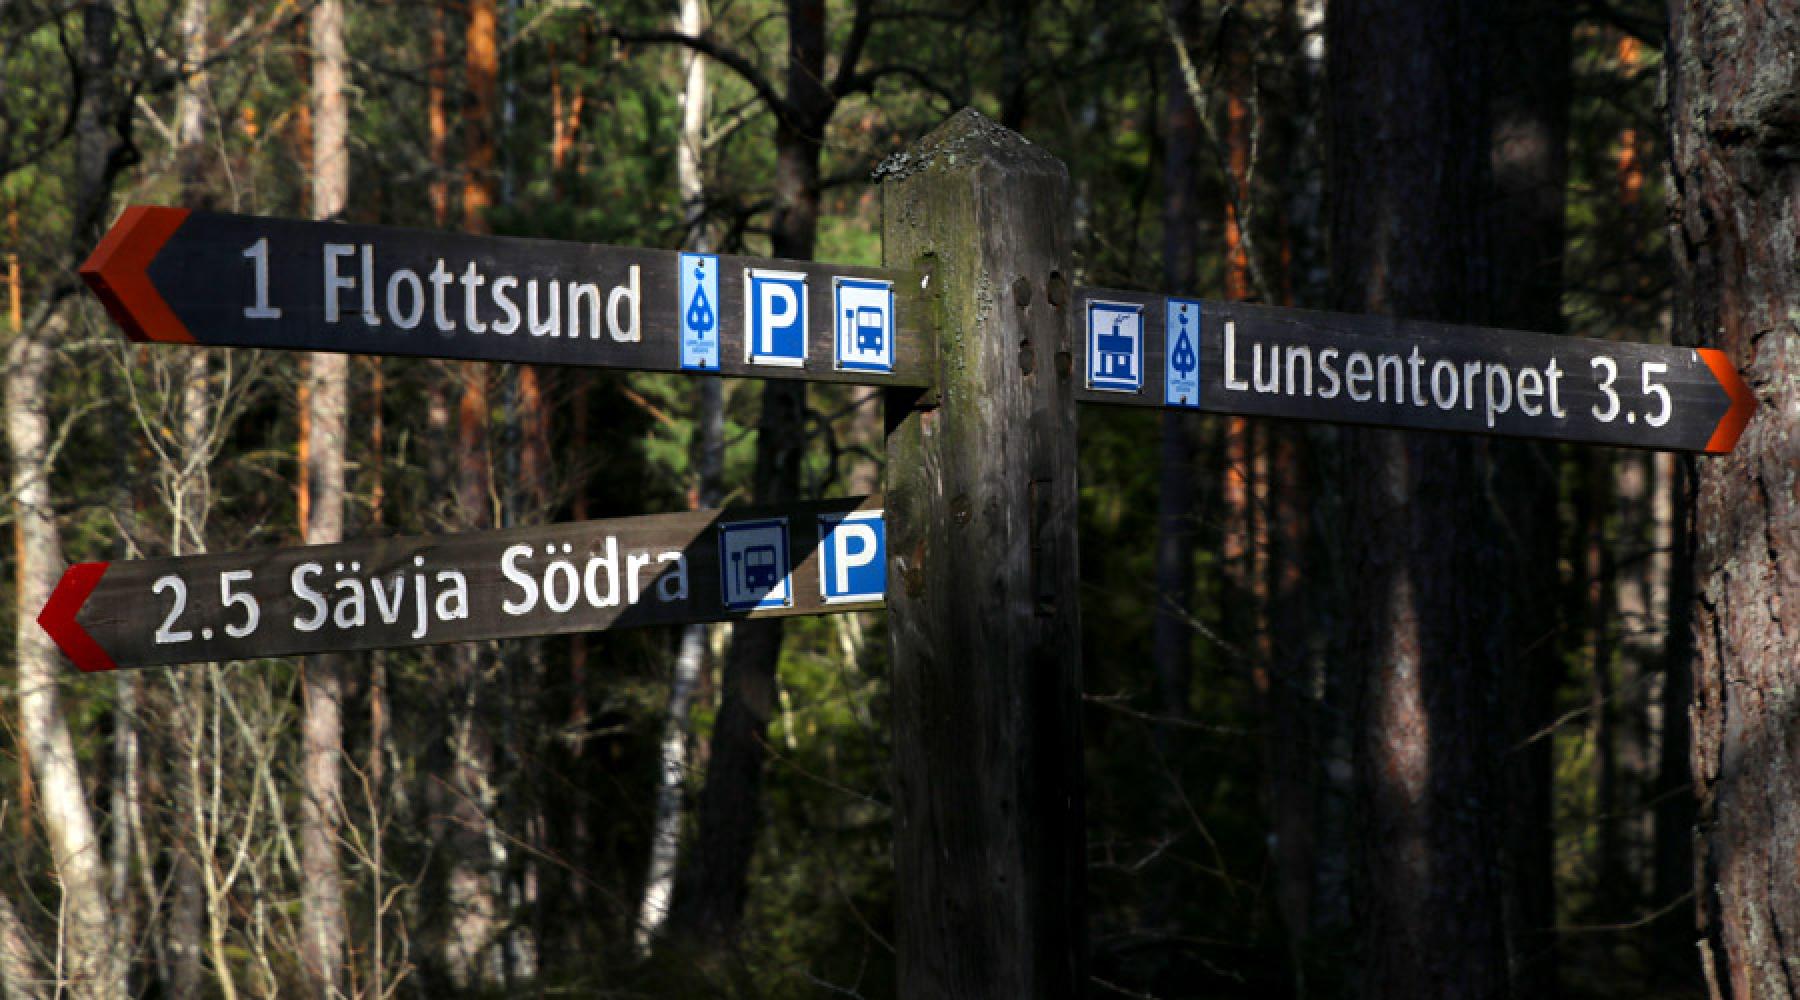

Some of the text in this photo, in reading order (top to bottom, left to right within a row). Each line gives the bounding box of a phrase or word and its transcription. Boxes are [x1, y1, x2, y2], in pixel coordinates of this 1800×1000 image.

[242, 237, 642, 343] 1 Flottsund
[759, 282, 799, 353] P
[1223, 320, 1673, 428] Lunsentorpet 3.5
[151, 534, 689, 645] 2.5 Sävja Södra
[834, 523, 877, 593] P
